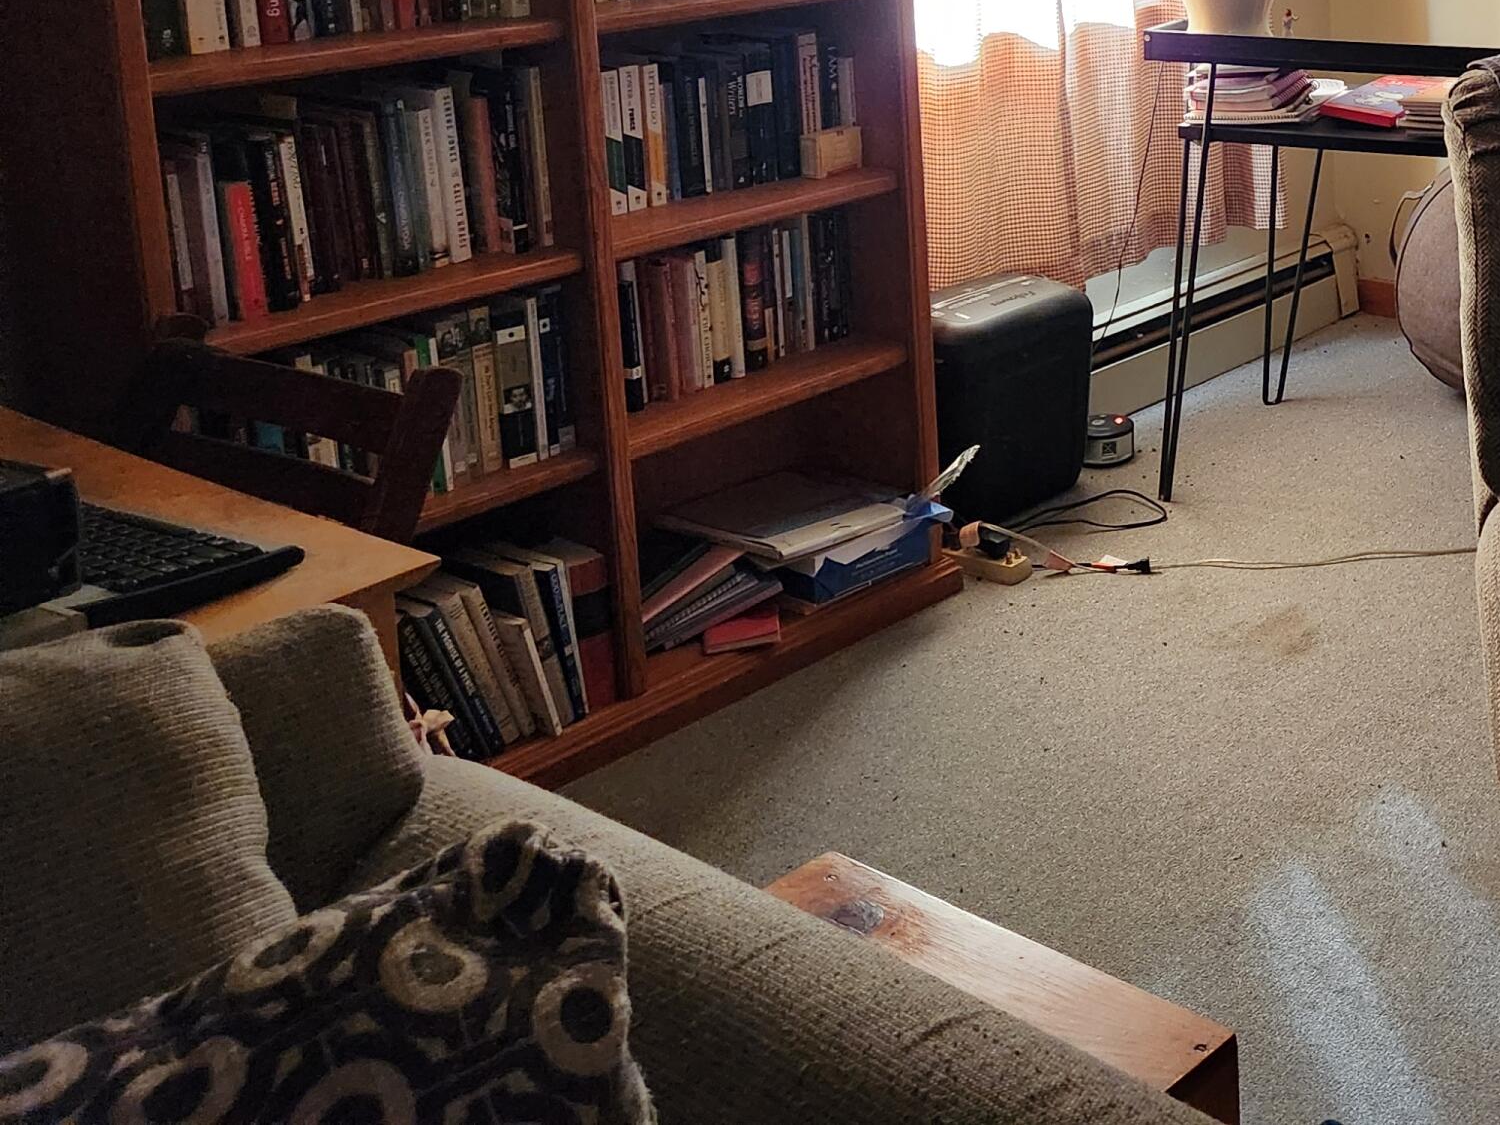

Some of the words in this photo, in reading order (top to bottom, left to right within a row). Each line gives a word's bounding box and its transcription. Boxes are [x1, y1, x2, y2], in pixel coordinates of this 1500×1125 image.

[827, 54, 837, 78] AM
[625, 70, 633, 99] POWER
[646, 69, 657, 103] LETTING
[726, 81, 737, 115] Writers
[441, 94, 454, 131] SERENE
[649, 107, 658, 124] GO
[445, 134, 458, 164] JONES
[451, 182, 463, 205] CALL
[454, 206, 464, 218] IT
[455, 220, 468, 249] GRACE
[702, 336, 711, 369] CHOICE
[432, 616, 447, 633] THE
